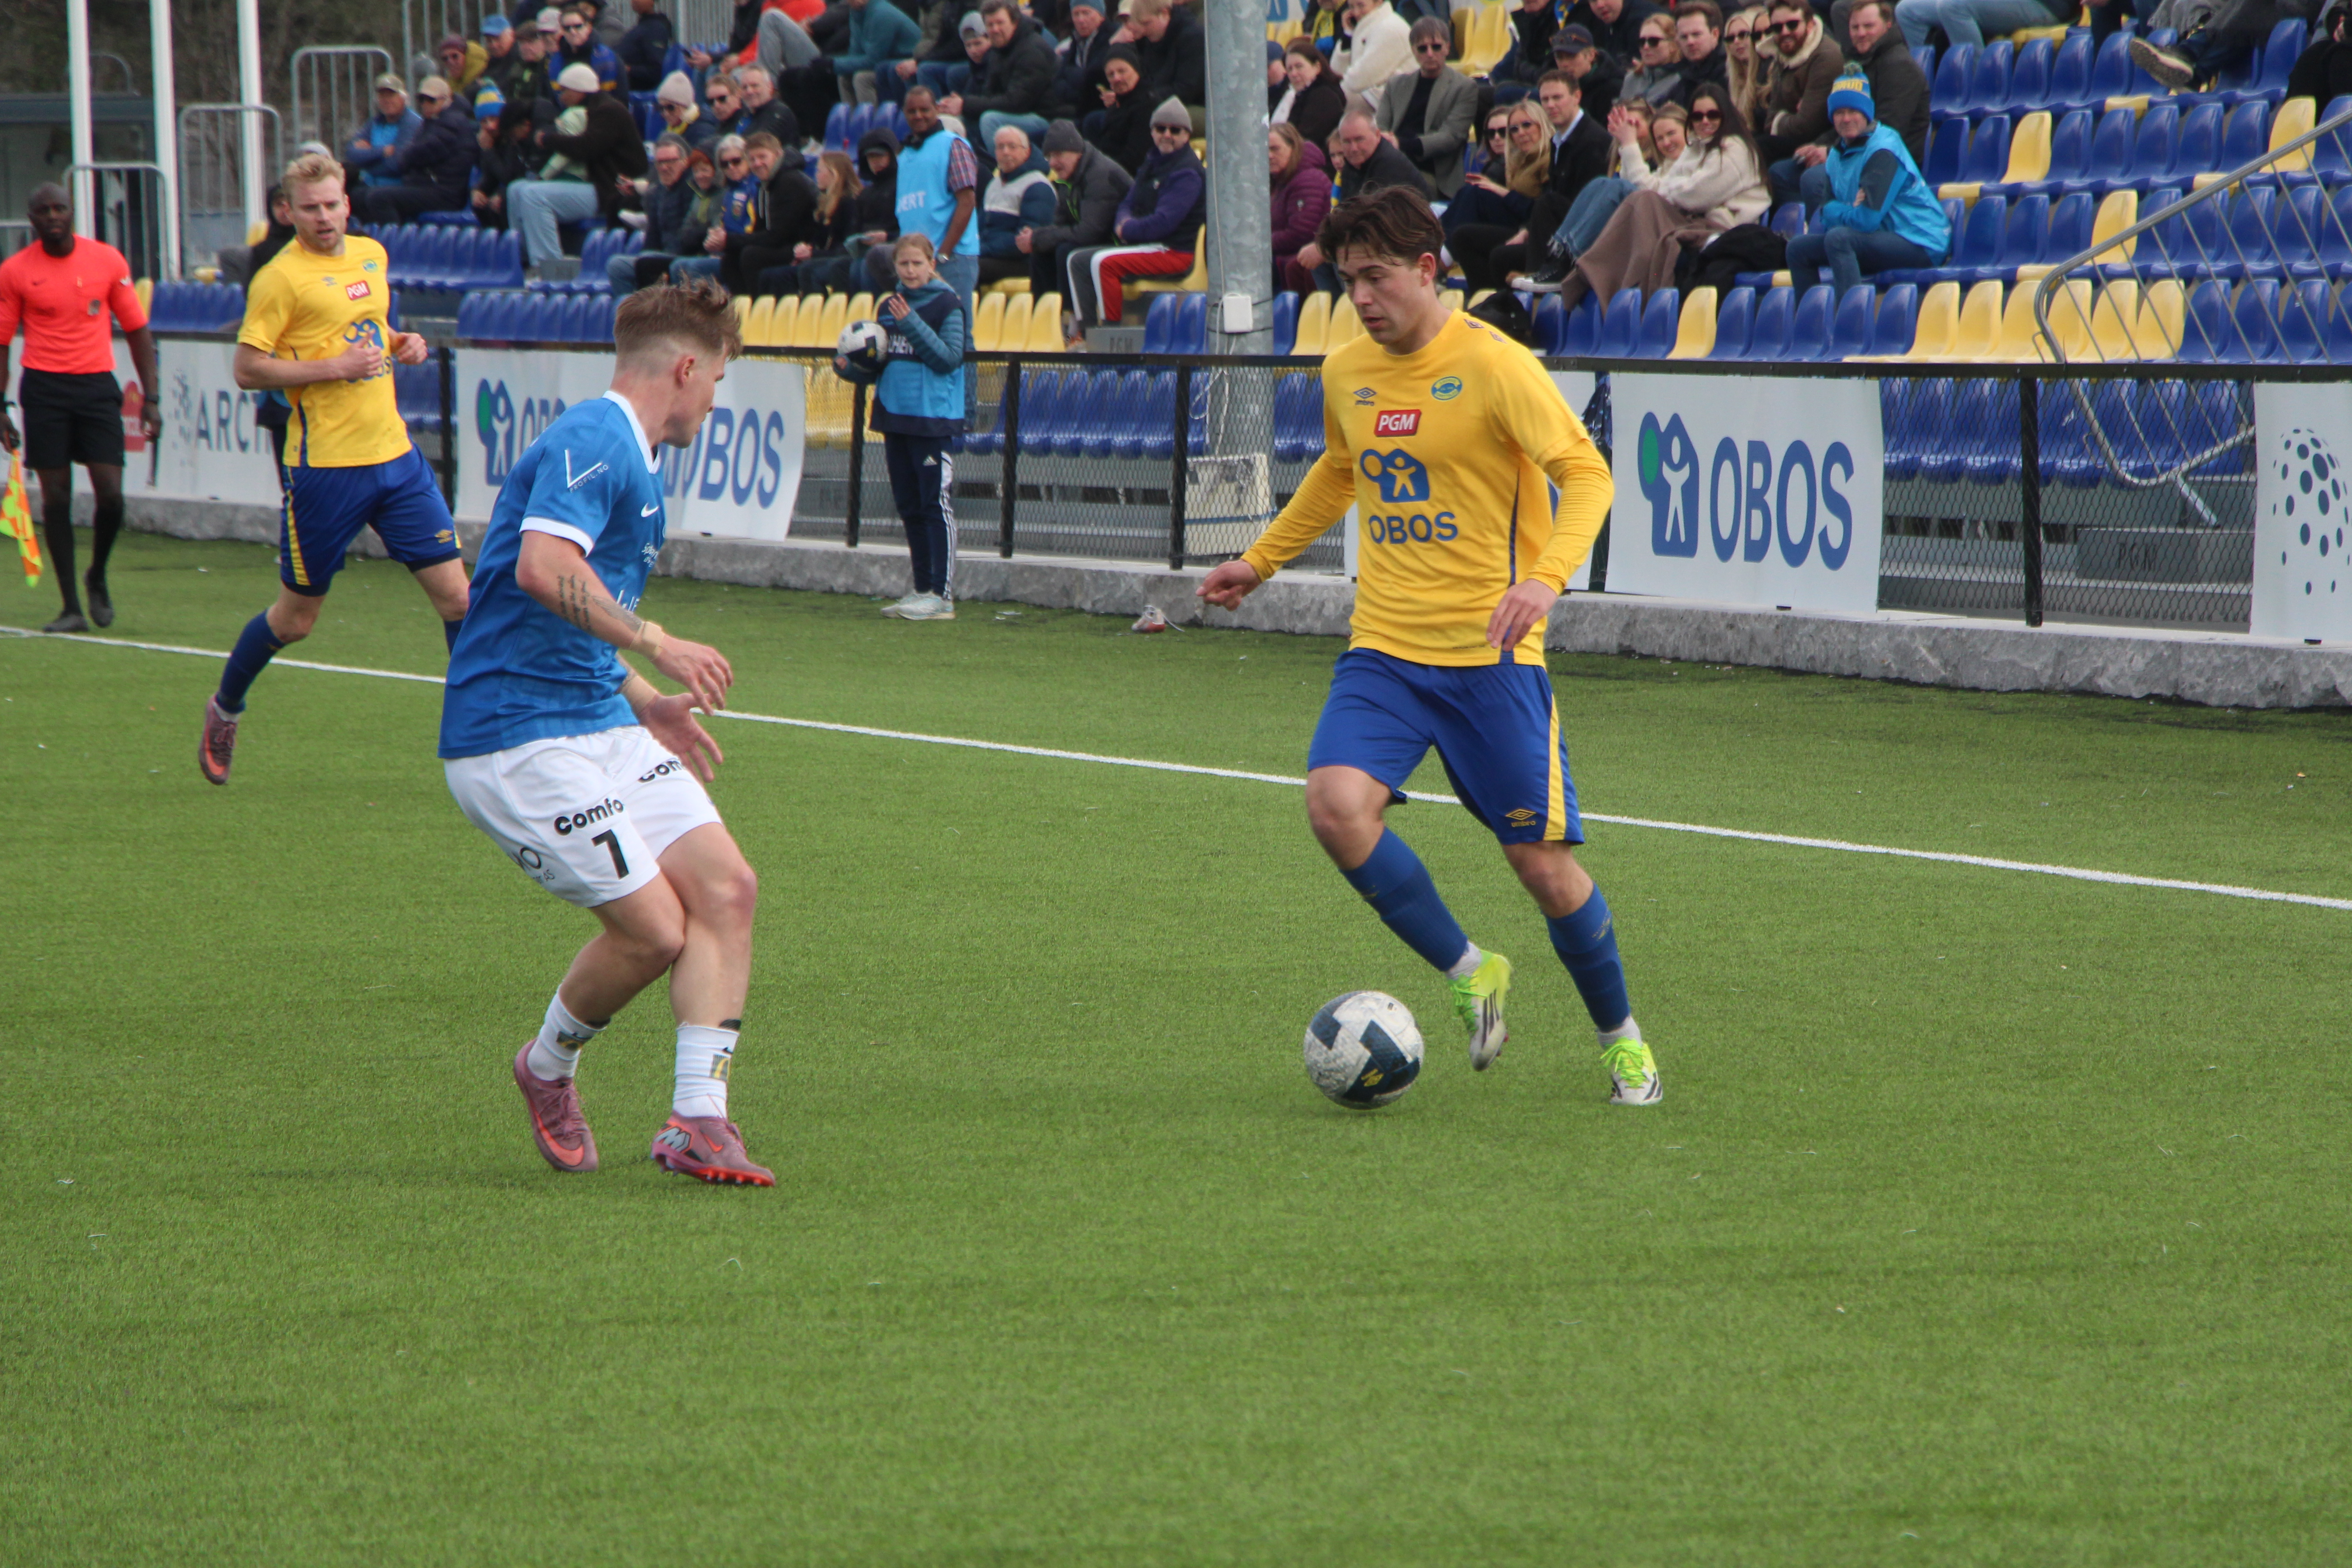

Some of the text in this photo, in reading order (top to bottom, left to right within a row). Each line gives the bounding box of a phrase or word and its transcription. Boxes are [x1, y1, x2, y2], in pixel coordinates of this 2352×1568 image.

[1378, 413, 1415, 431] PGM
[569, 465, 608, 493] PROFIL.NO
[1710, 436, 1854, 571] OBOS
[1369, 511, 1458, 544] OBOS
[591, 829, 629, 880] 7
